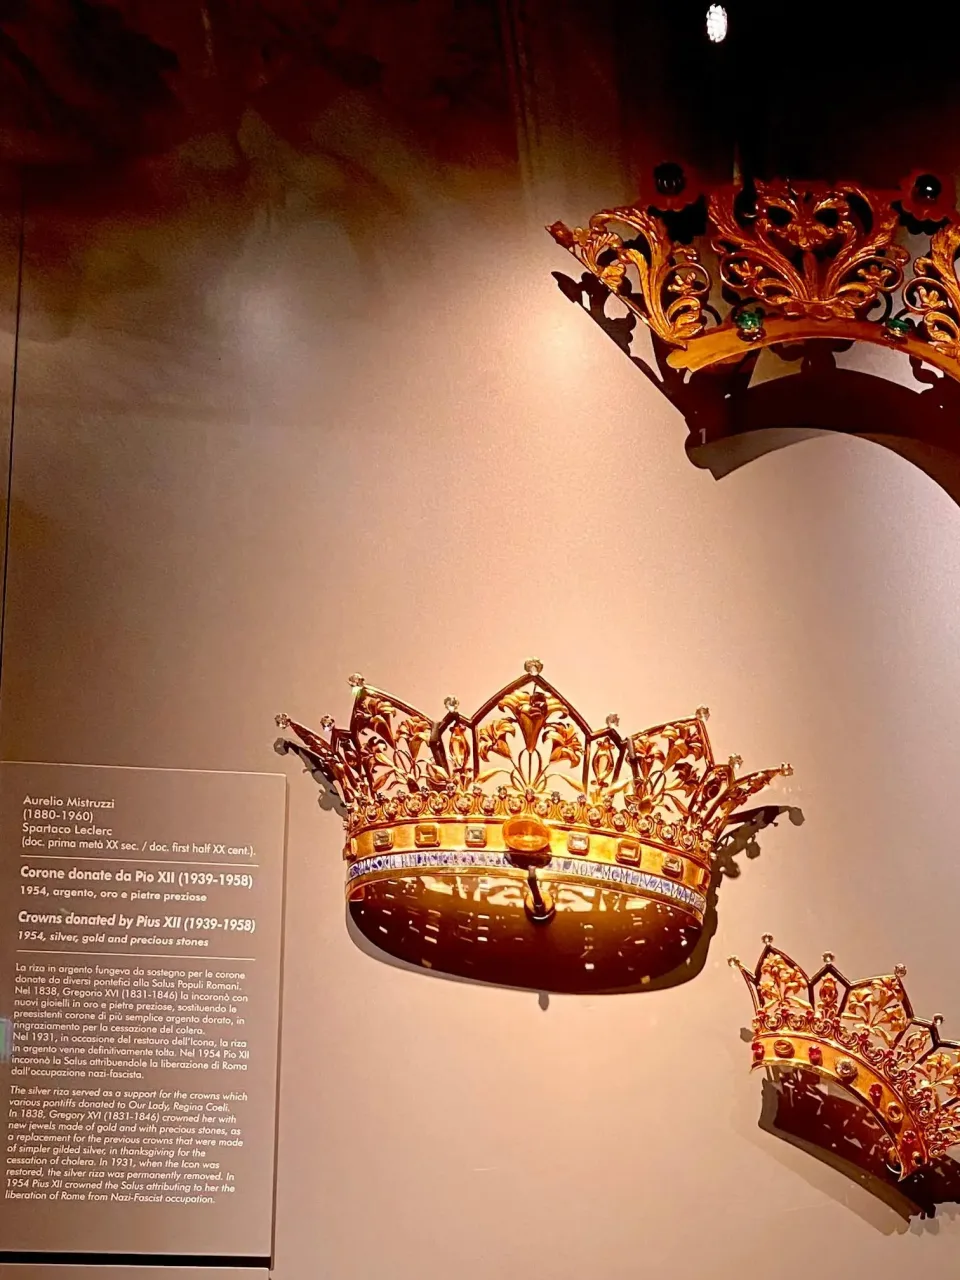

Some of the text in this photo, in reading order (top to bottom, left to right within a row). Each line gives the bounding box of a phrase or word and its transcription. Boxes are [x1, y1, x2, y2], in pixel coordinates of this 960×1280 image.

[699, 428, 706, 444] 1
[22, 795, 114, 808] Aurelio Mistruzzi
[23, 808, 93, 823] (1880-1960)
[22, 822, 112, 835] Spartaco Leclerc
[21, 835, 45, 847] (doc.
[47, 837, 76, 849] prima
[78, 840, 103, 849] metà
[105, 839, 118, 849] XX
[120, 842, 138, 850] sec.
[149, 841, 169, 851] doc.
[171, 841, 189, 852] first
[192, 842, 211, 853] half
[212, 844, 225, 854] XX
[227, 845, 256, 857] cent.).
[20, 866, 252, 889] Corone donate da Pio XII (1939-1958)
[20, 885, 49, 896] 1954,
[52, 889, 97, 898] argento,
[130, 889, 160, 901] pietre
[163, 891, 207, 902] preziose
[18, 910, 255, 933] Crowns donated by Pius XII (1939-1958)
[18, 930, 208, 946] 1954, silver, gold and precious stones
[14, 974, 46, 983] donate
[48, 975, 60, 984] da
[62, 975, 90, 985] diversi
[93, 977, 130, 987] pontefici
[132, 977, 149, 987] alla
[151, 978, 175, 988] Salus
[177, 979, 203, 990] Populi
[14, 986, 30, 994] Nel
[62, 987, 102, 998] Gregorio
[104, 988, 118, 997] XVI
[180, 990, 188, 1000] la
[191, 991, 229, 1001] incoronò
[8, 1108, 17, 1117] In
[48, 1109, 85, 1121] Gregory
[86, 1111, 101, 1119] XVI
[161, 1113, 200, 1122] crowned
[201, 1113, 216, 1122] her
[218, 1114, 236, 1123] with
[4, 1190, 46, 1199] liberation
[48, 1191, 59, 1199] of
[60, 1191, 85, 1200] Rome
[87, 1191, 108, 1200] from
[110, 1192, 163, 1202] Nazi-Fascist
